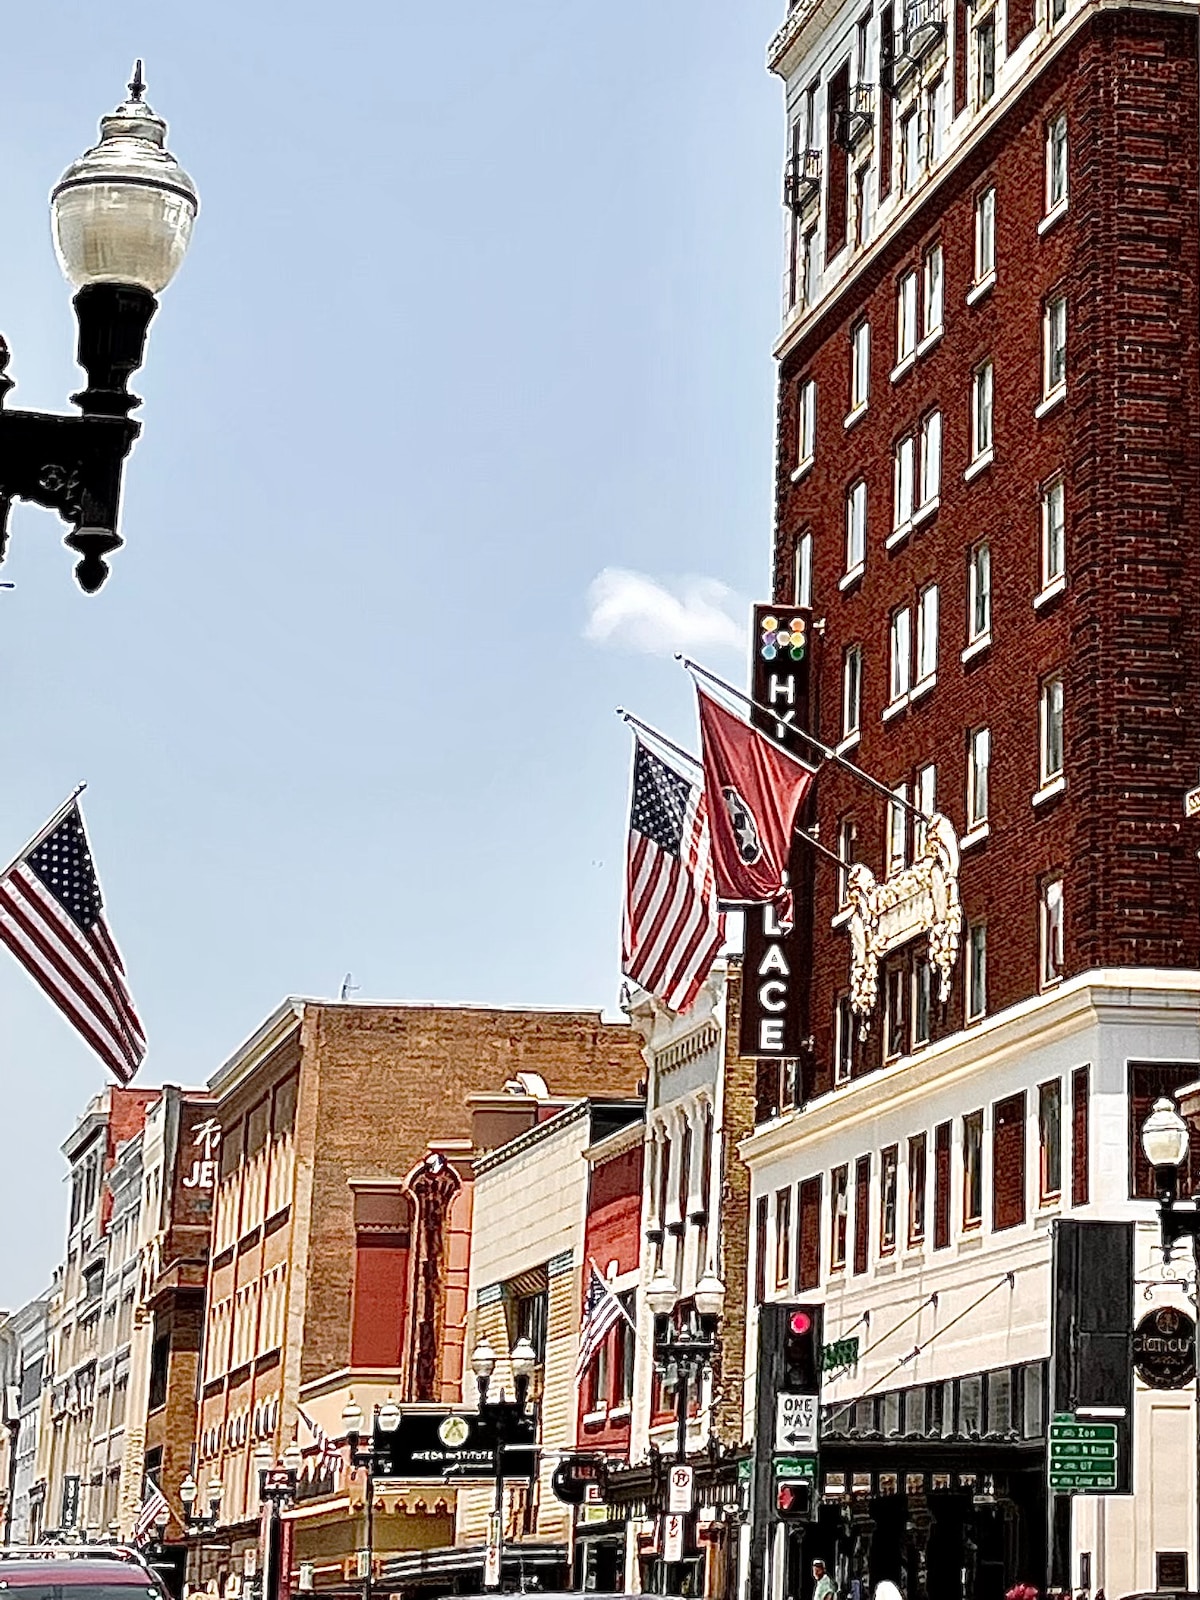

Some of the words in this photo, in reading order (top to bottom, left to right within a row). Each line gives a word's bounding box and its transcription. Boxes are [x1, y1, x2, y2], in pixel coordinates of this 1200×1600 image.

[757, 866, 793, 1051] LACE
[784, 1398, 813, 1413] ONE
[783, 1414, 813, 1427] WAY
